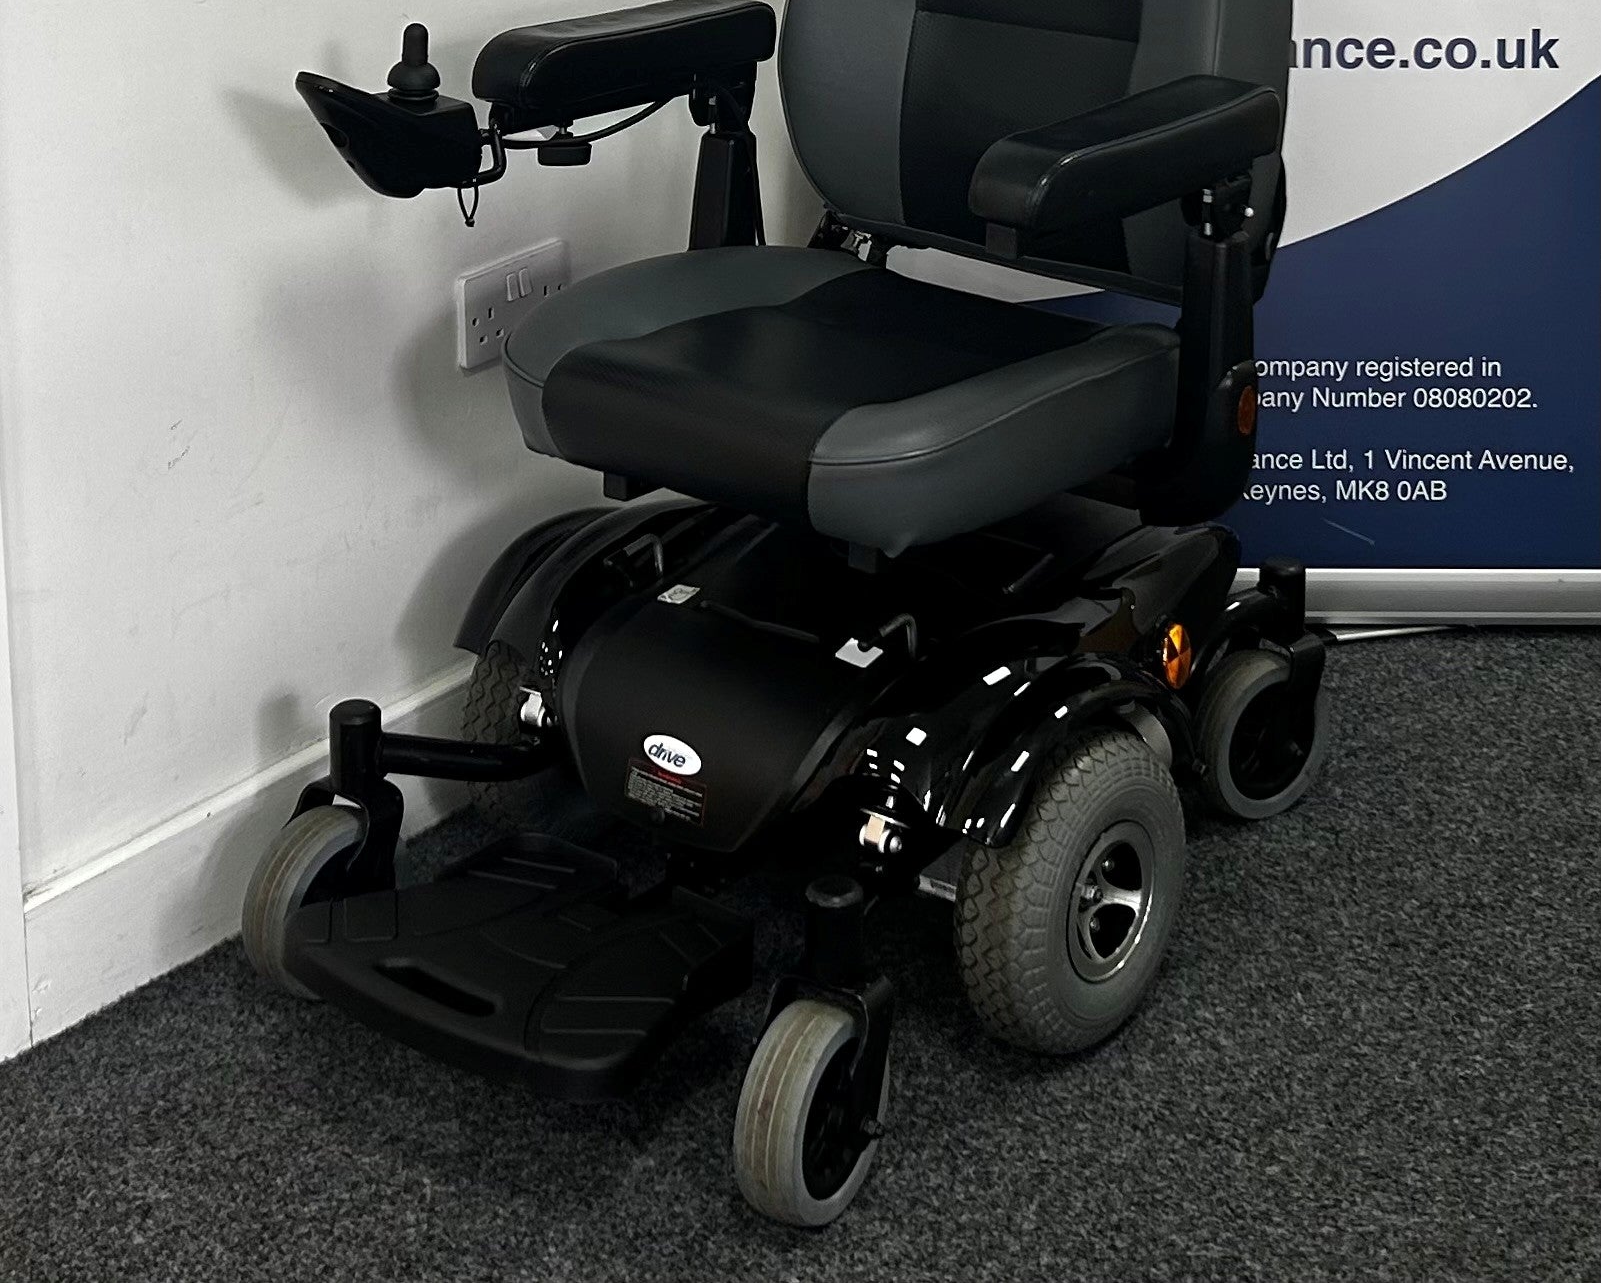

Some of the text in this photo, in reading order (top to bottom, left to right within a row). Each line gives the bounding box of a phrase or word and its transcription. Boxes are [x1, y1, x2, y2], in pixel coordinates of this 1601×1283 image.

[1290, 28, 1560, 70] nce.co.uk
[1255, 356, 1502, 383] ompany registered in
[1257, 386, 1538, 413] any Number 08080202.
[1252, 448, 1575, 473] ance Ltd, 1 Vincent Avenue,
[1336, 480, 1390, 501] MK8
[1397, 480, 1448, 501] 0AB
[648, 742, 686, 768] drive
